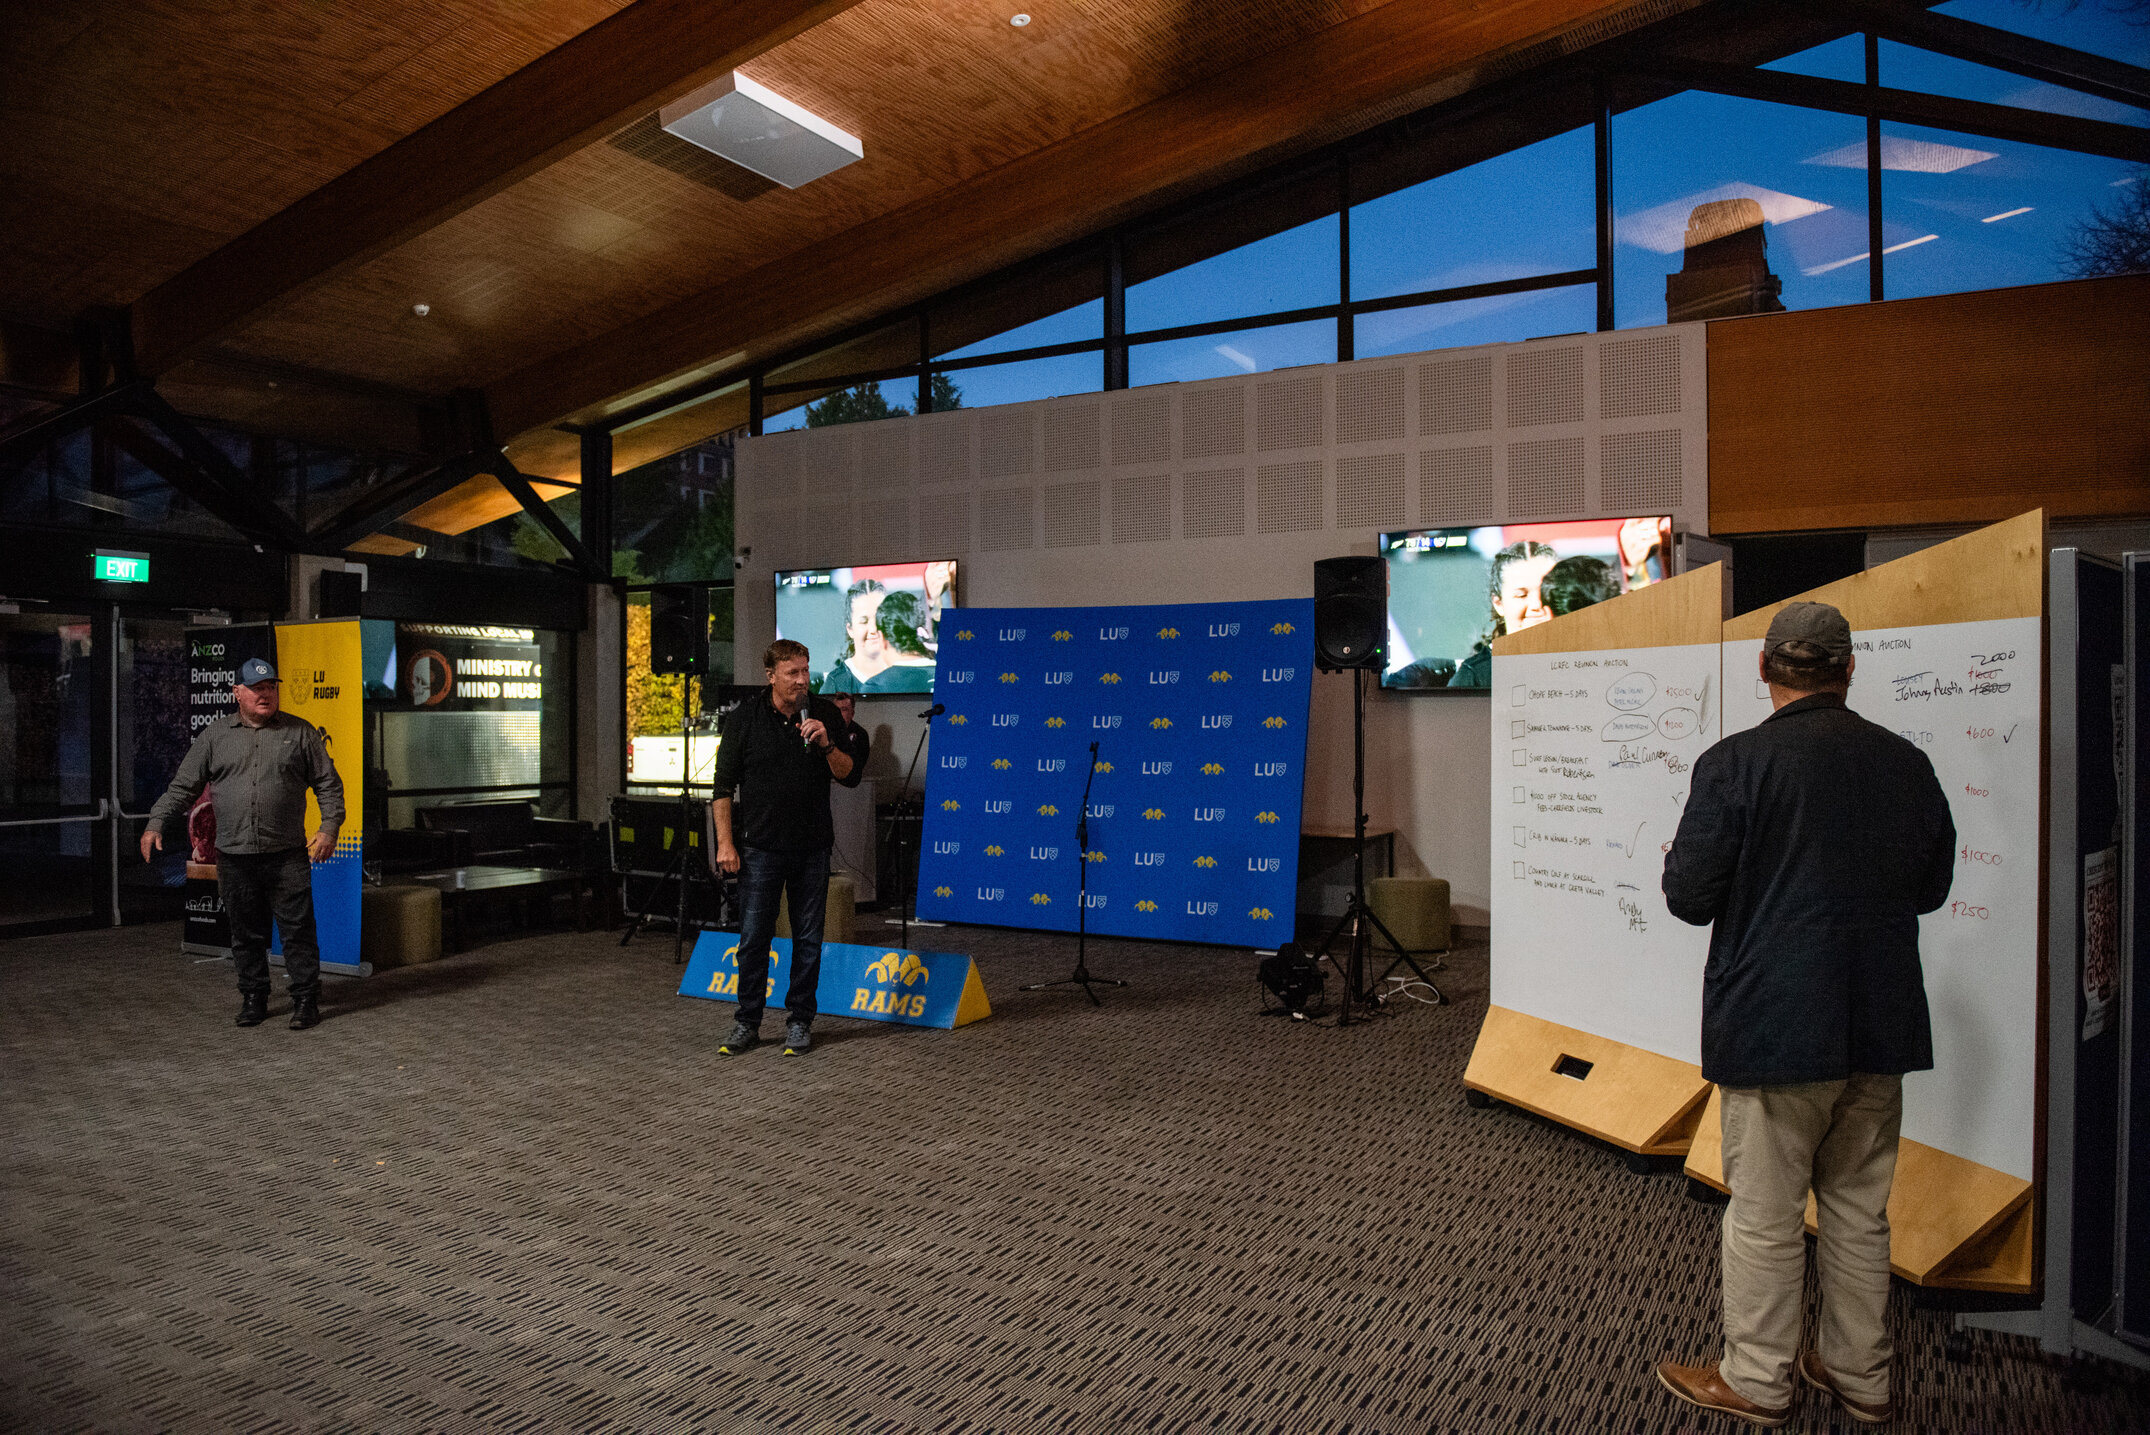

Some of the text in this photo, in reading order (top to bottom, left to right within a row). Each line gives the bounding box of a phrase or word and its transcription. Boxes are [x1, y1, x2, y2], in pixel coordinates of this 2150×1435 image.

[107, 560, 137, 578] EXIT
[401, 622, 481, 637] SUPPORTING
[479, 625, 520, 639] LOCAL
[1000, 629, 1018, 641] LU
[1100, 628, 1118, 640] LU
[1209, 624, 1231, 637] LU
[191, 644, 225, 657] ANZCO
[1879, 638, 1911, 651] AUCTION
[1603, 658, 1629, 668] AUCTION
[1971, 650, 2016, 666] 2000
[457, 659, 533, 676] MINISTRY
[191, 668, 236, 687] Bringing
[313, 670, 325, 683] LU
[949, 672, 967, 683] LU
[1045, 672, 1064, 684] LU
[1150, 672, 1168, 684] LU
[1263, 669, 1285, 681] LU
[313, 686, 340, 700] RUGBY
[457, 681, 502, 698] MIND
[191, 689, 236, 705] nutrition
[993, 715, 1011, 726] LU
[1093, 716, 1112, 728] LU
[1202, 716, 1221, 728] LU
[1966, 725, 1995, 744] $600
[942, 756, 958, 768] LU
[1038, 760, 1058, 771] LU
[1143, 762, 1163, 774] LU
[1255, 763, 1277, 776] LU
[1965, 783, 1989, 797] $1000
[985, 801, 1004, 813] LU
[1195, 808, 1216, 821] LU
[935, 841, 950, 854] LU
[1031, 847, 1050, 859] LU
[1135, 853, 1156, 865] LU
[1961, 845, 2003, 866] $1000
[1248, 858, 1271, 871] LU
[978, 888, 995, 900] LU
[1188, 901, 1209, 915] LU
[1951, 901, 1989, 920] $250
[707, 972, 776, 998] RAS
[851, 988, 927, 1018] RAMS
